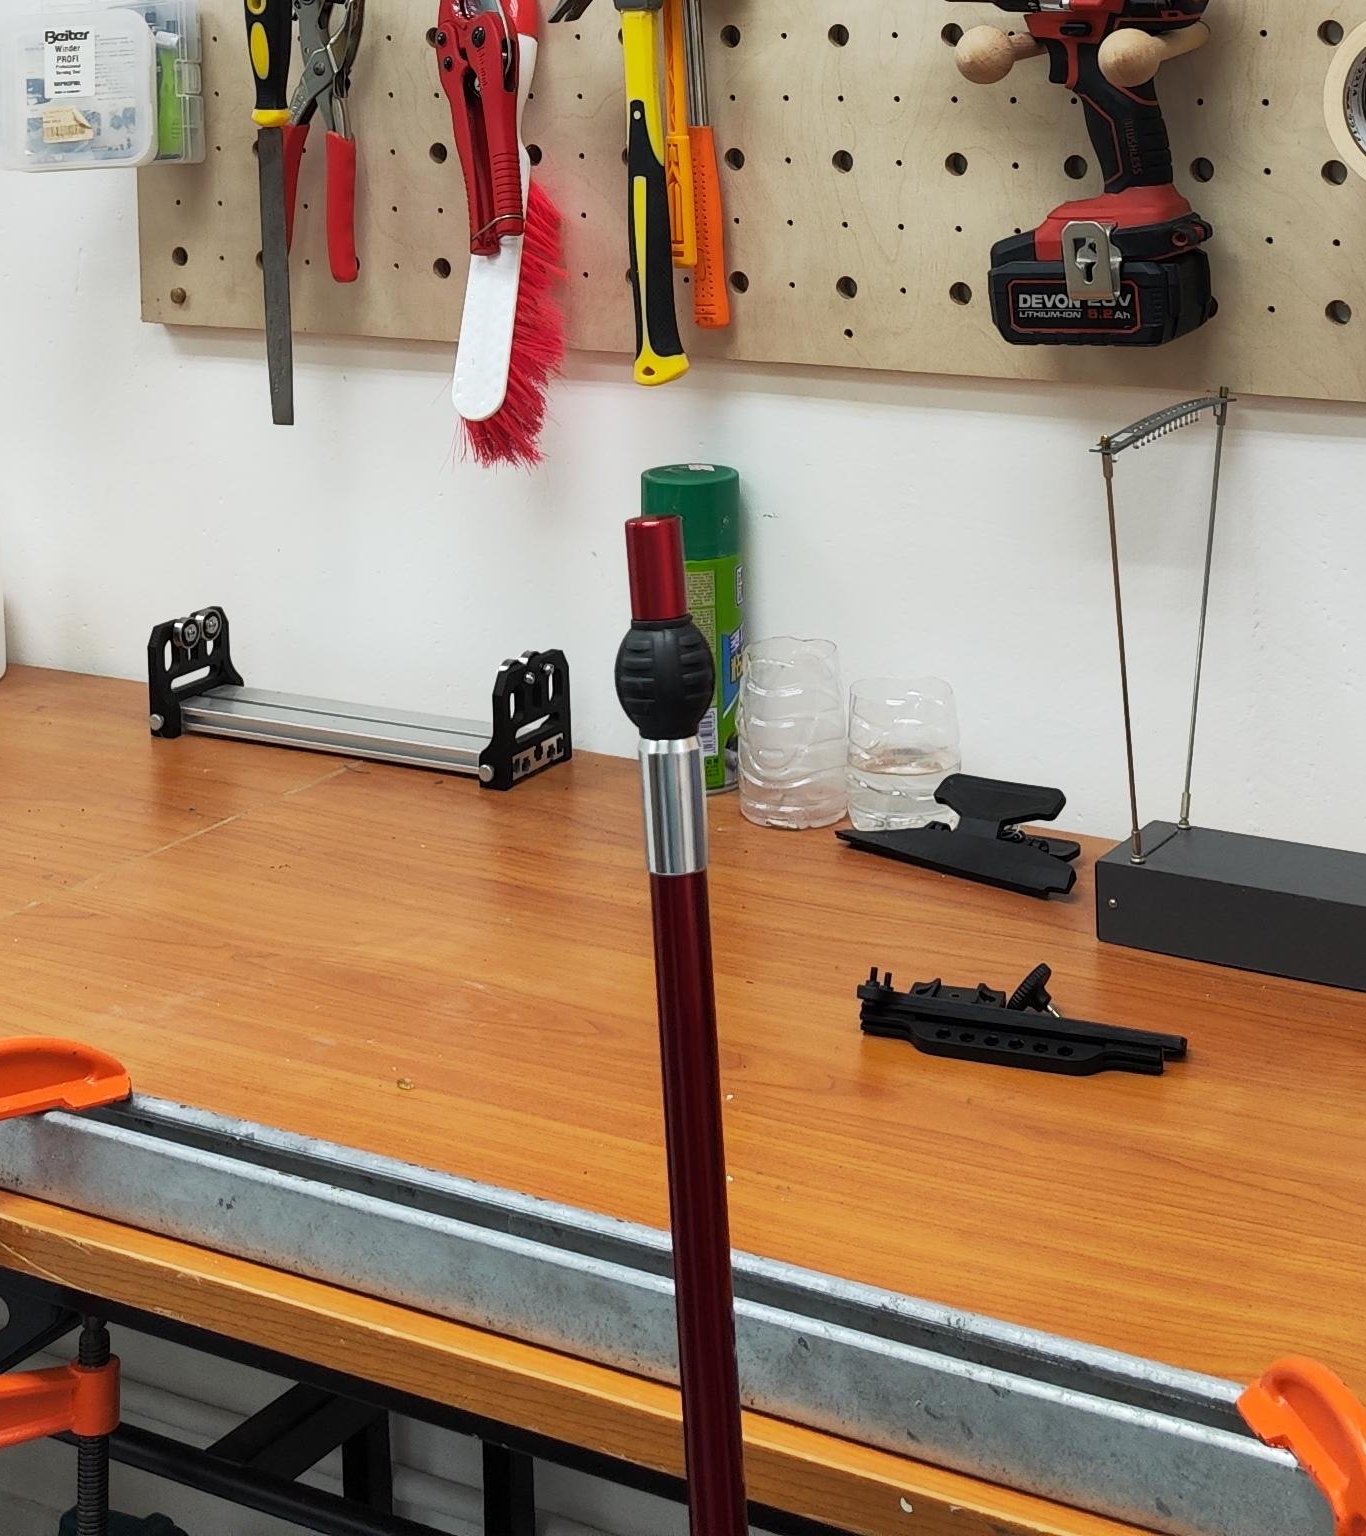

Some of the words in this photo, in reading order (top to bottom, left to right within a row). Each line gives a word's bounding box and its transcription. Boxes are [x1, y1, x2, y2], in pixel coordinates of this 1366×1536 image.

[44, 30, 90, 45] Beiter
[56, 55, 79, 63] PROFI
[1018, 310, 1082, 319] LITHIUM-ION
